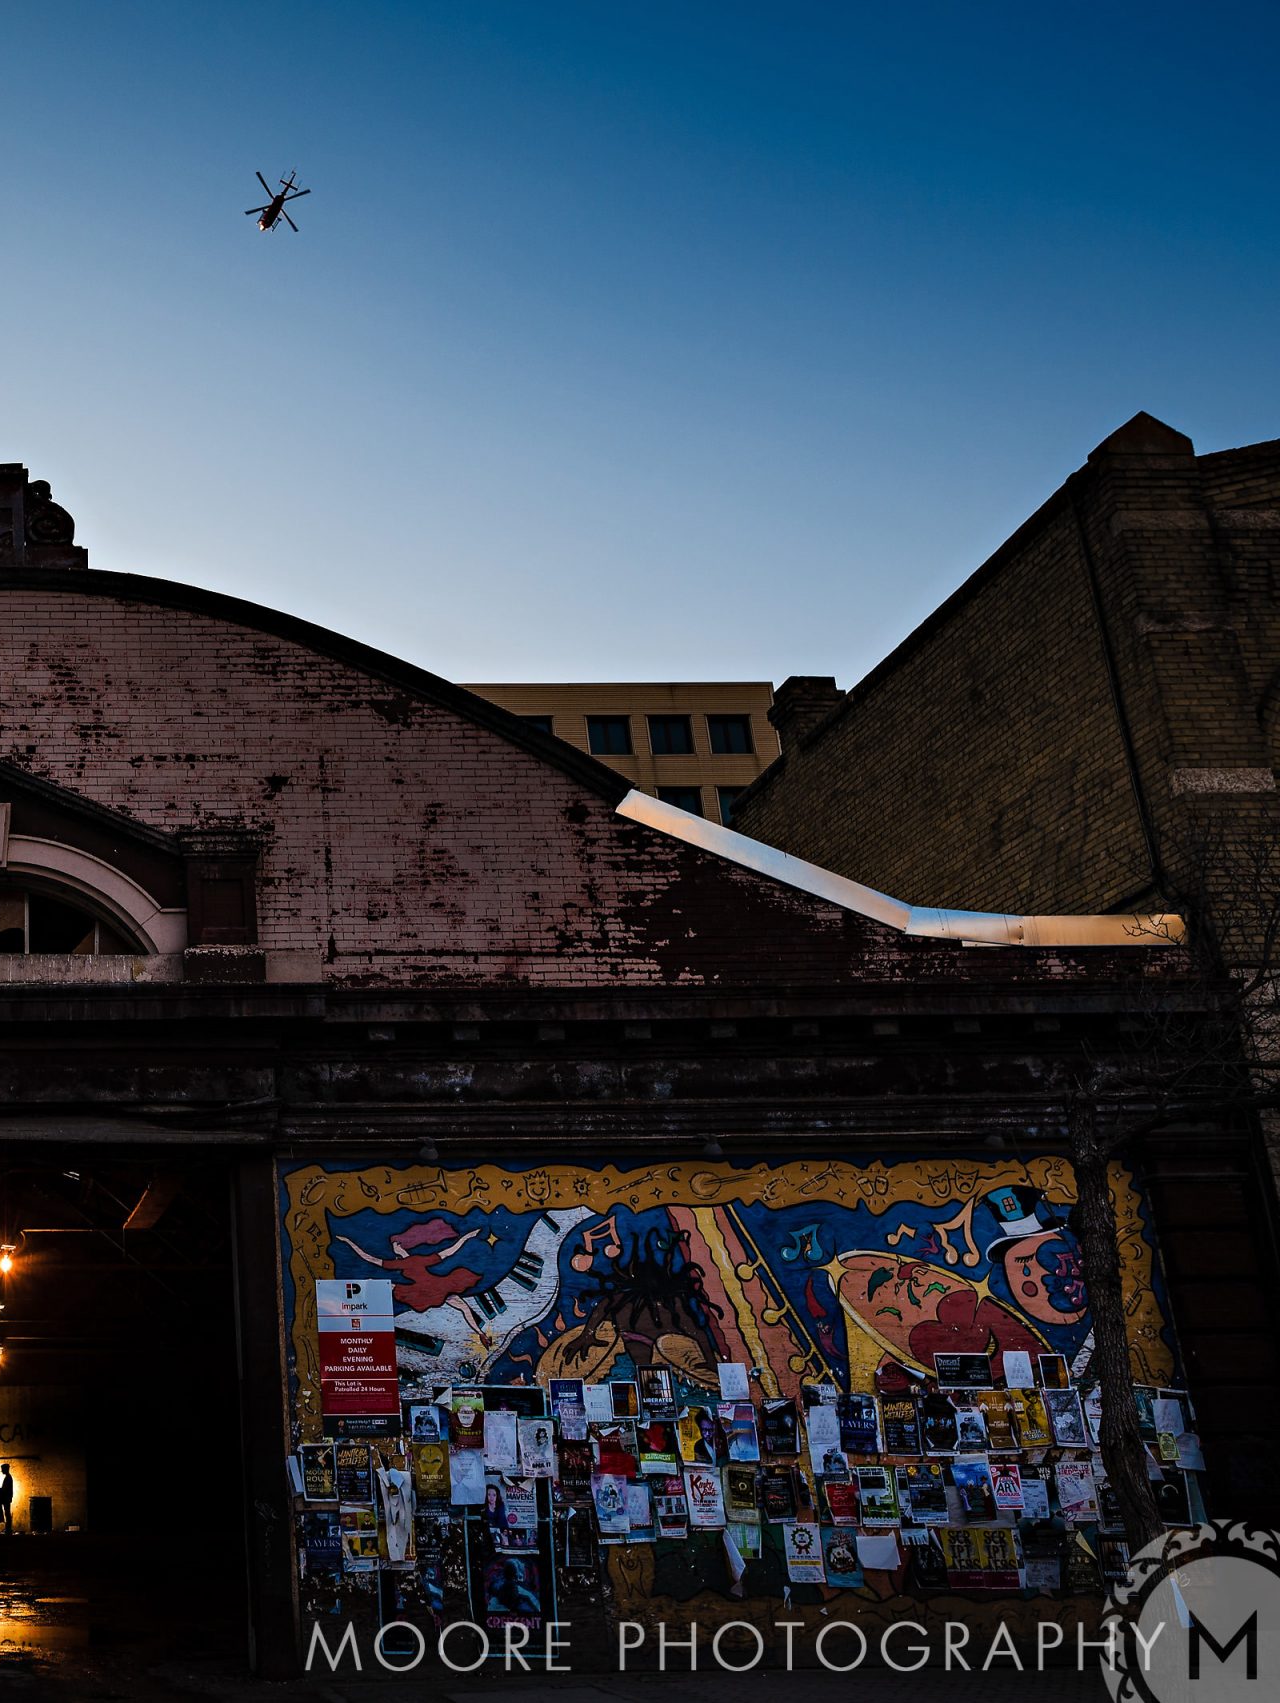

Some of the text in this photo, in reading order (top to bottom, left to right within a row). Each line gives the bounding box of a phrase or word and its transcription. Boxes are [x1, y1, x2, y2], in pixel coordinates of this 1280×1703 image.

[341, 1302, 368, 1312] impark
[340, 1337, 373, 1345] MONTHLY
[883, 1402, 913, 1412] MANITOBA
[840, 1420, 875, 1430] LAYERS
[337, 1449, 368, 1459] MANITOBA
[997, 1482, 1018, 1493] ART
[506, 1493, 535, 1501] MAVENS
[305, 1537, 342, 1548] LAYERS
